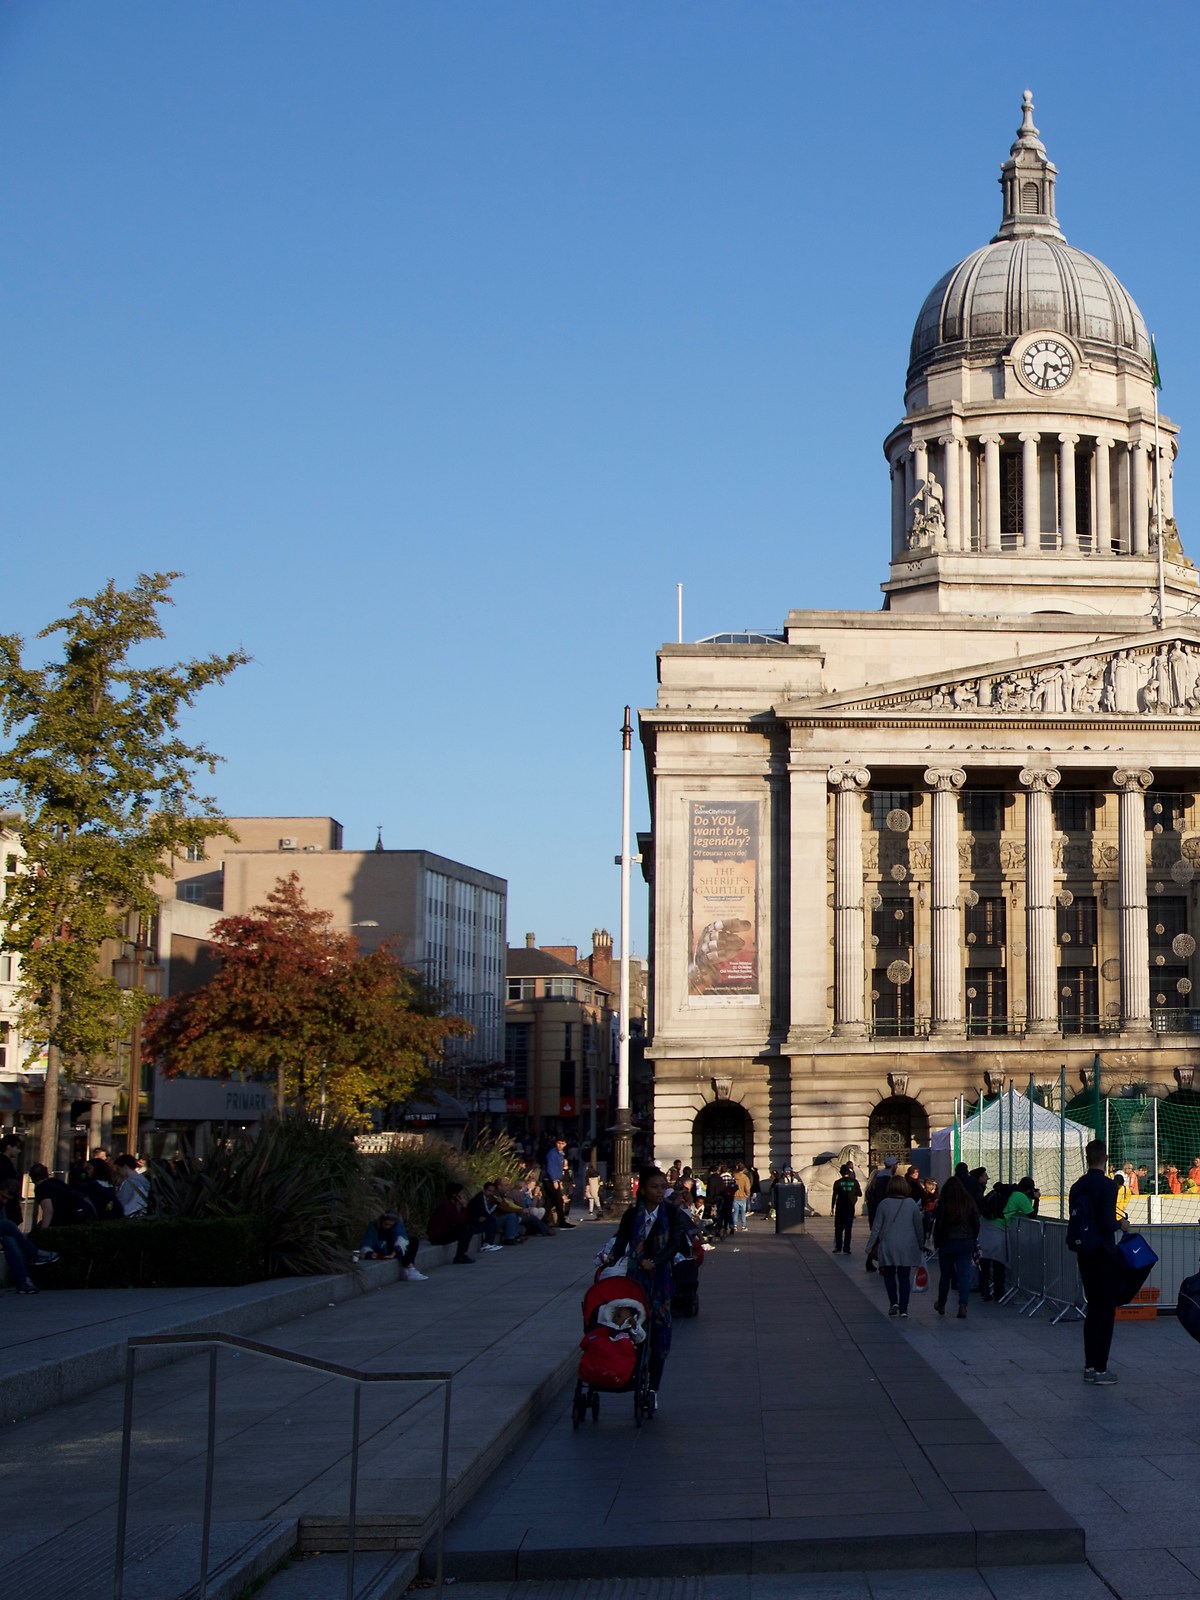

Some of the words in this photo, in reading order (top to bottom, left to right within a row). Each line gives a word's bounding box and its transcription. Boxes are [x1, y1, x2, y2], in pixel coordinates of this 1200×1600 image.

[693, 816, 709, 826] Do
[711, 815, 736, 826] YOU
[693, 827, 721, 836] want
[722, 827, 734, 836] to
[736, 825, 750, 836] be
[693, 836, 751, 847] legendary?
[713, 867, 735, 876] THE
[699, 877, 749, 885] SHERIFF'S
[695, 886, 753, 895] GAUNTLET
[226, 1092, 267, 1110] PRIMARK
